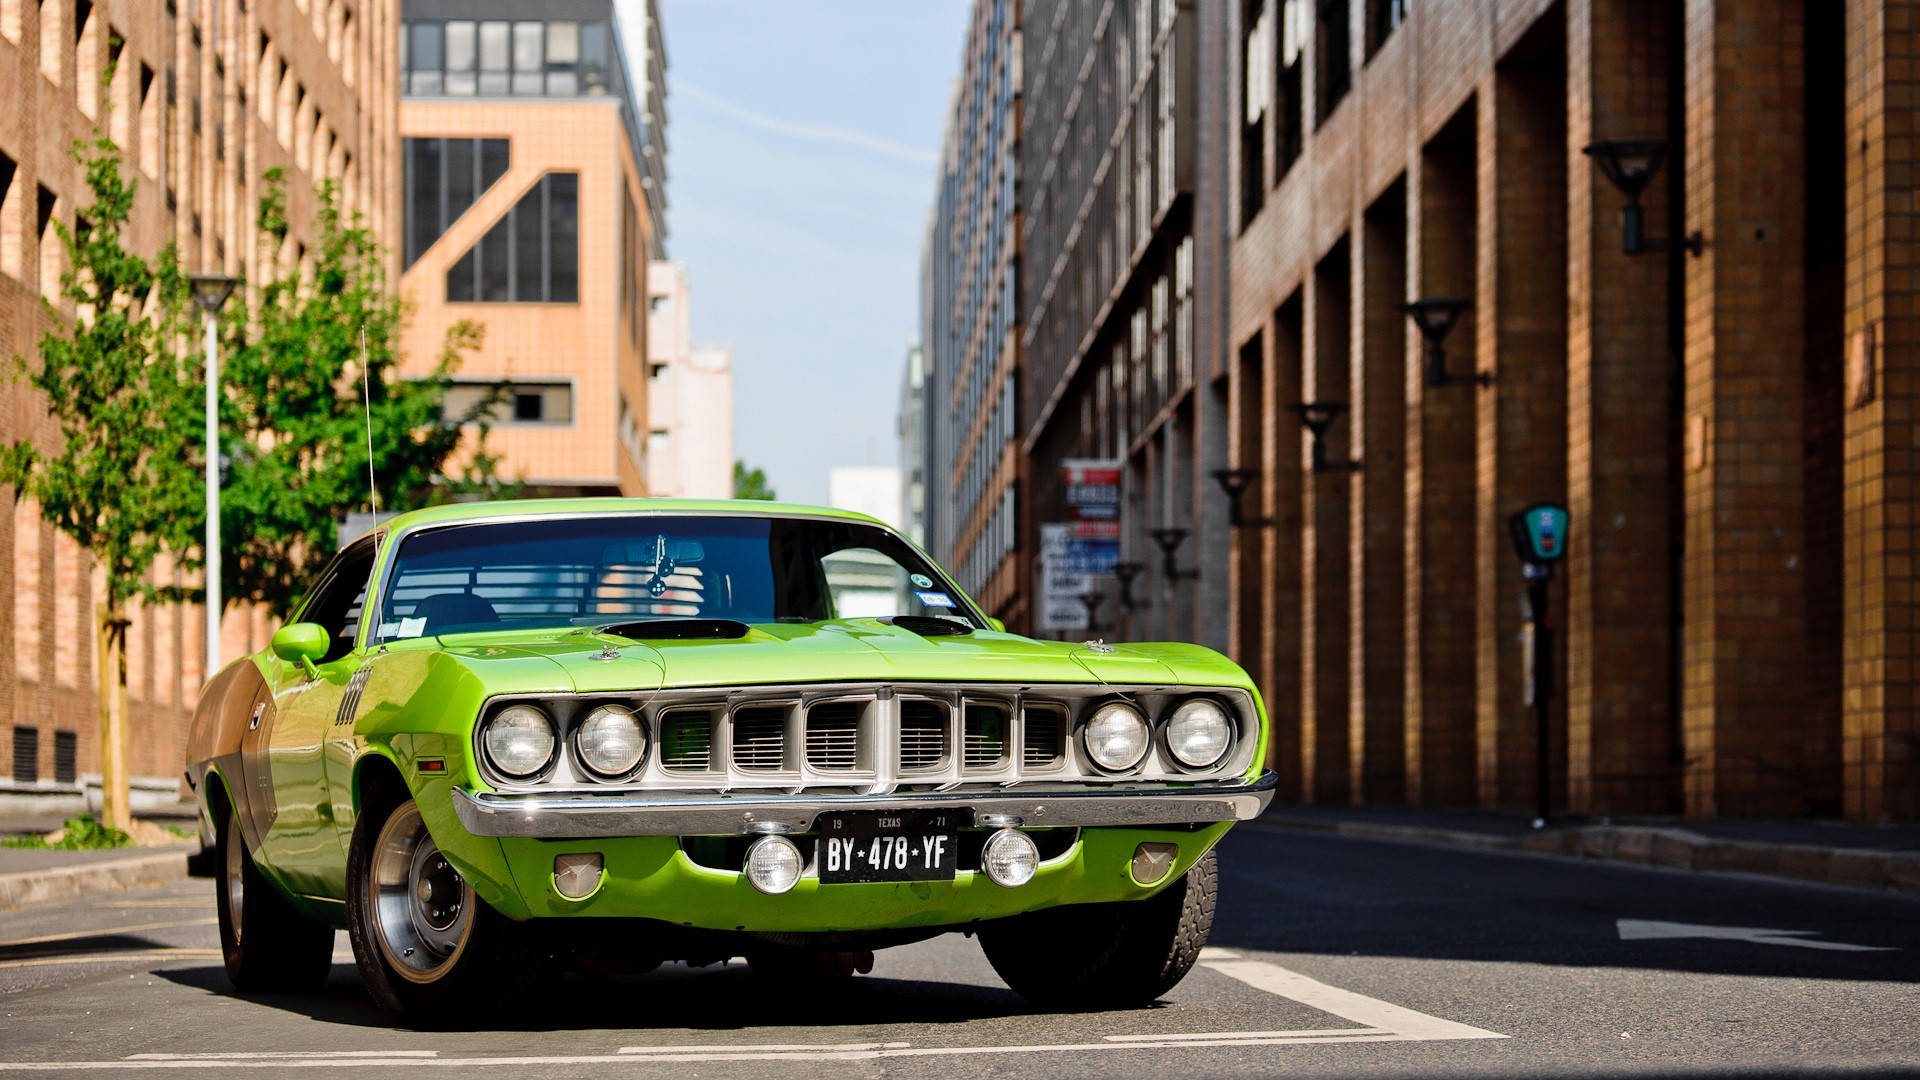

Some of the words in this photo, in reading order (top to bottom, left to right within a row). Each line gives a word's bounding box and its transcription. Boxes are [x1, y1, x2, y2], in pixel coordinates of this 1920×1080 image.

[833, 819, 842, 829] 19
[878, 817, 901, 828] TEXAS
[937, 816, 945, 826] 71
[827, 837, 855, 872] BY
[868, 836, 908, 870] 478
[923, 835, 948, 869] YF
